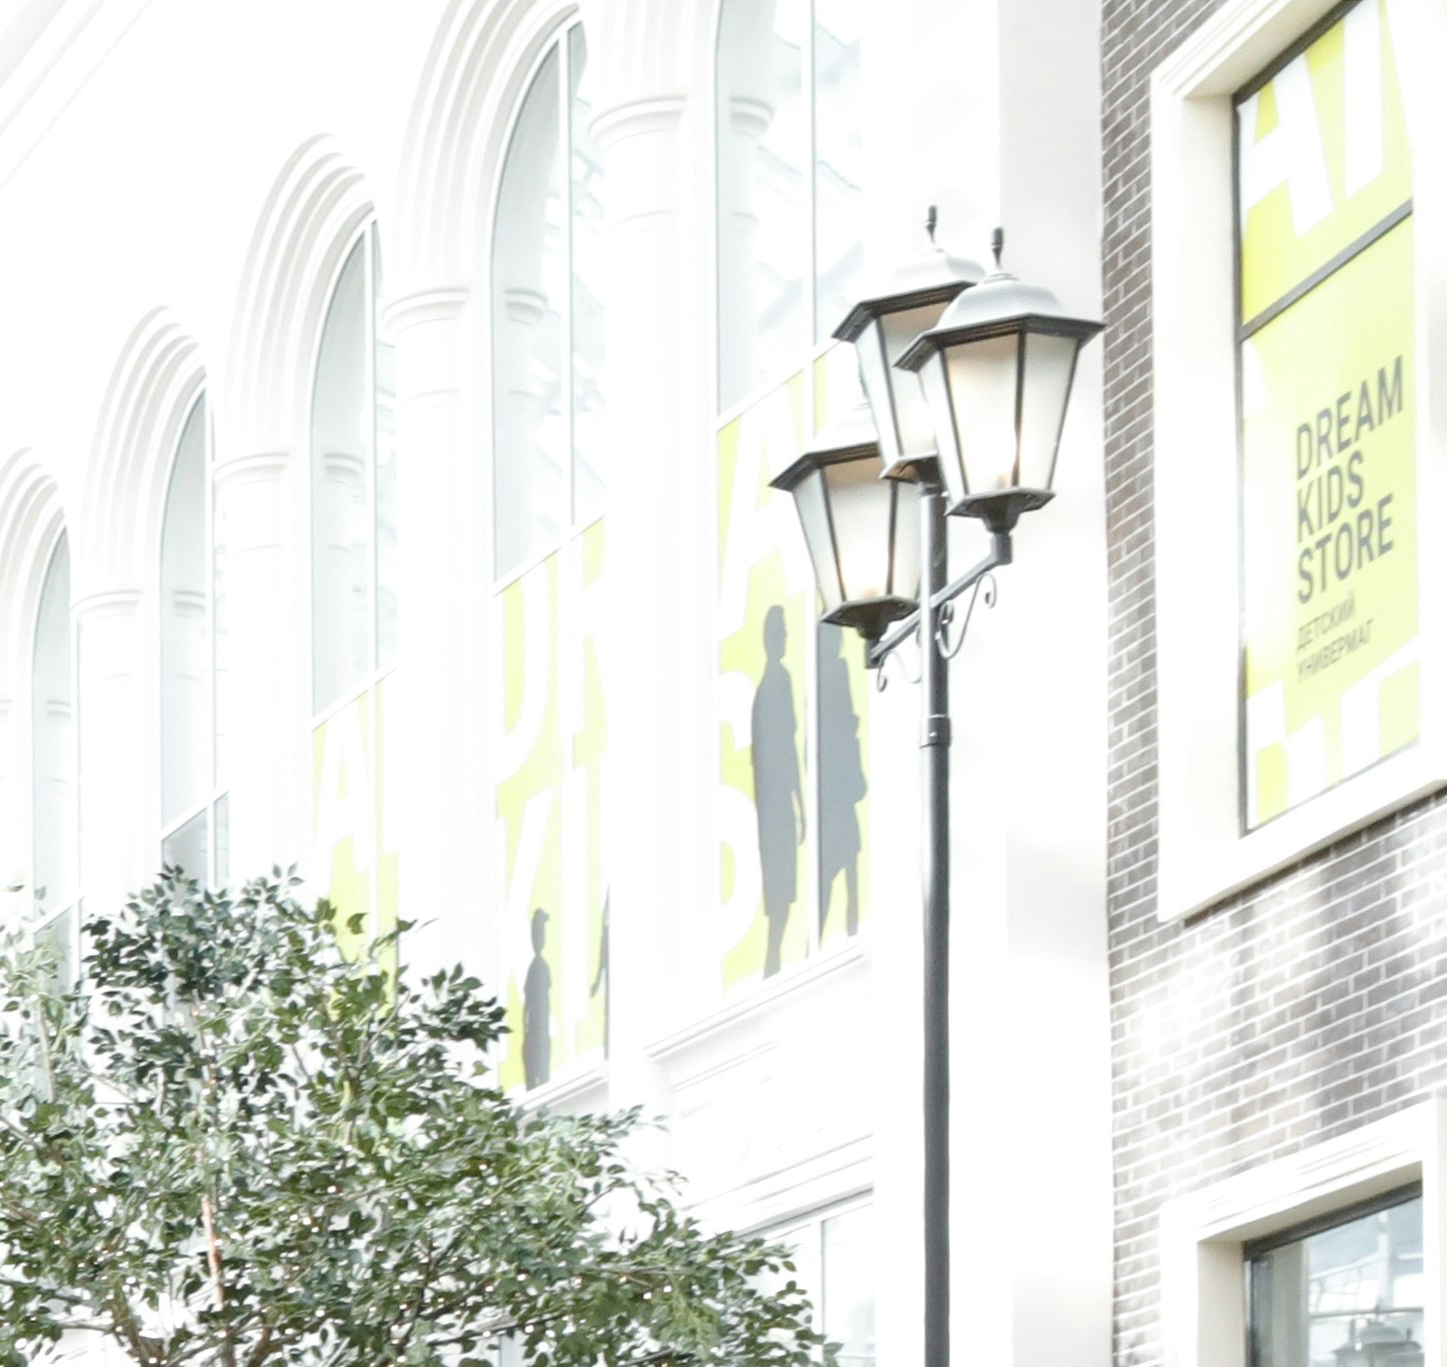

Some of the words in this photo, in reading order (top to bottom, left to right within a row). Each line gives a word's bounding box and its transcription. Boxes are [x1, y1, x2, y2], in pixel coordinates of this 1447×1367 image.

[1296, 354, 1403, 481] DREAM
[1296, 450, 1364, 544] KIDS
[1296, 492, 1394, 604] STORE
